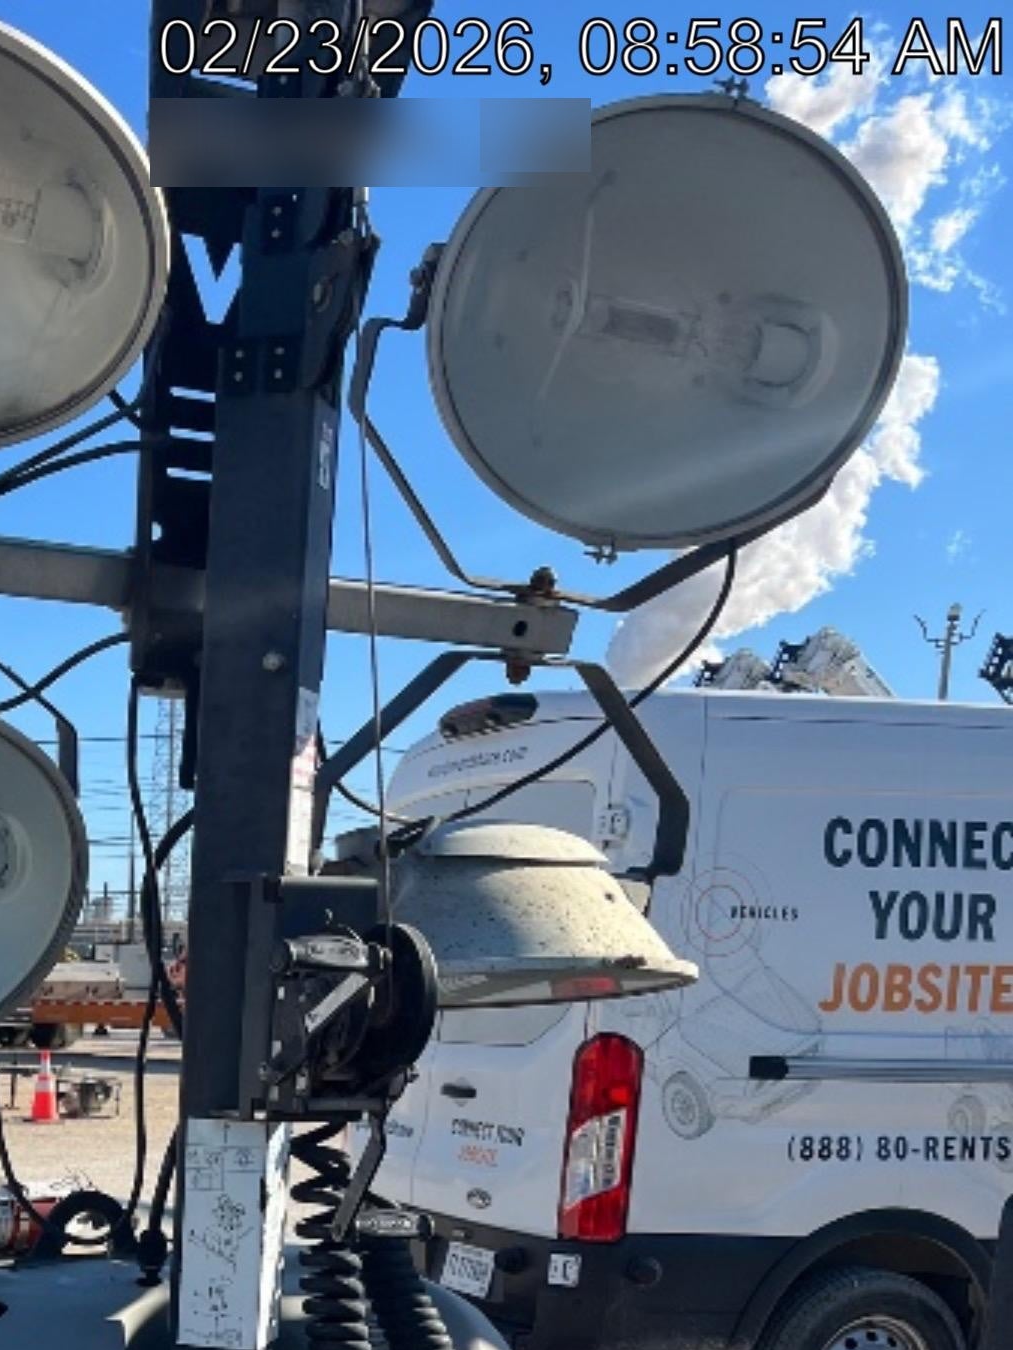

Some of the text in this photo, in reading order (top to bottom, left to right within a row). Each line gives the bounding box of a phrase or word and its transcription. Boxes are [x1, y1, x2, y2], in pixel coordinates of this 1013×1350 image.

[824, 817, 1013, 870] CONNEC
[730, 905, 799, 921] VEHICLES
[868, 891, 996, 942] YOUR
[818, 963, 1013, 1014] JOBSITE
[788, 1136, 1012, 1162] (888) 80-RENTS
